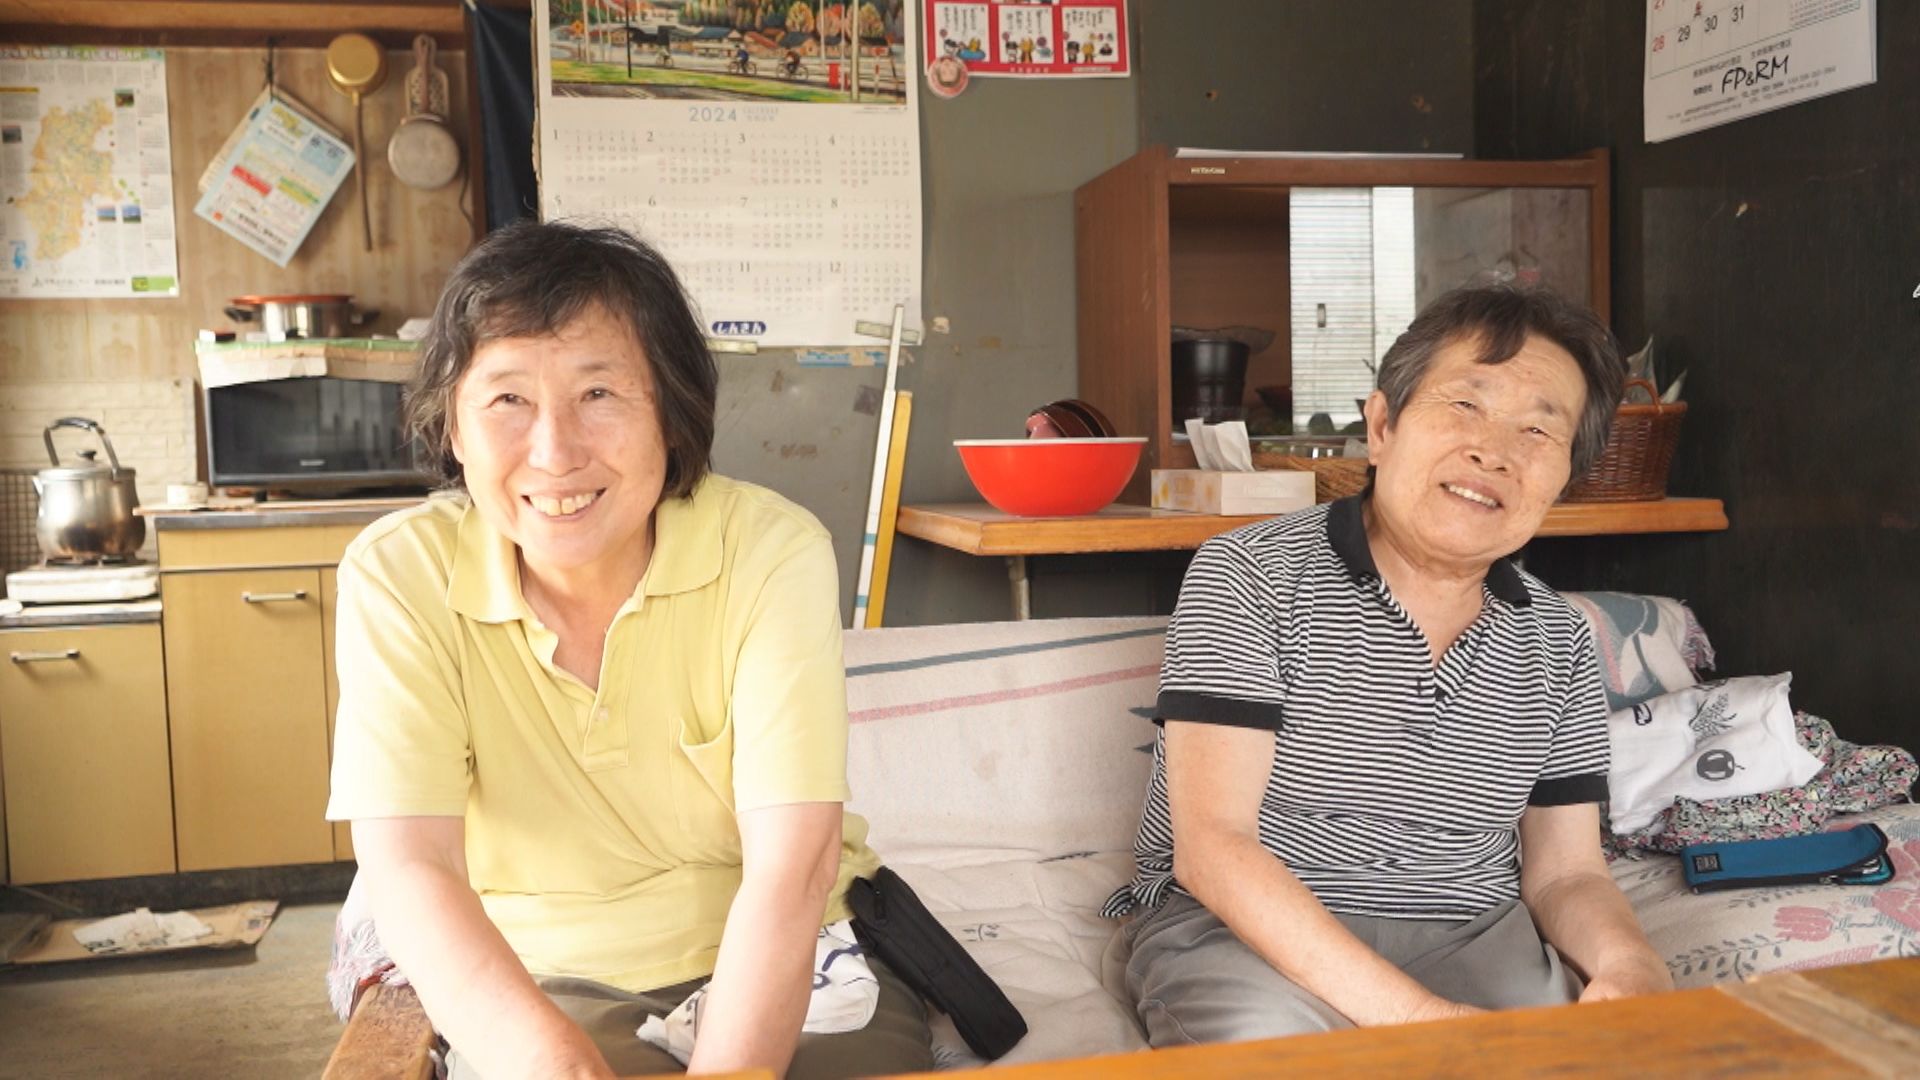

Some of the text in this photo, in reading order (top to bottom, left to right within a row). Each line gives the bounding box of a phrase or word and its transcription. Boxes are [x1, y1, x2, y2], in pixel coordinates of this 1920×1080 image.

[1652, 5, 1744, 52] 28 29 30 31
[1721, 54, 1790, 94] FP&RM
[688, 106, 738, 122] 2024
[647, 131, 654, 142] 2
[738, 133, 746, 144] 3
[828, 134, 835, 145] 4
[648, 196, 656, 207] 6
[740, 197, 748, 207] 7
[830, 198, 838, 208] 8
[740, 261, 750, 273] 11
[830, 262, 841, 273] 12
[716, 321, 764, 335] しんきん
